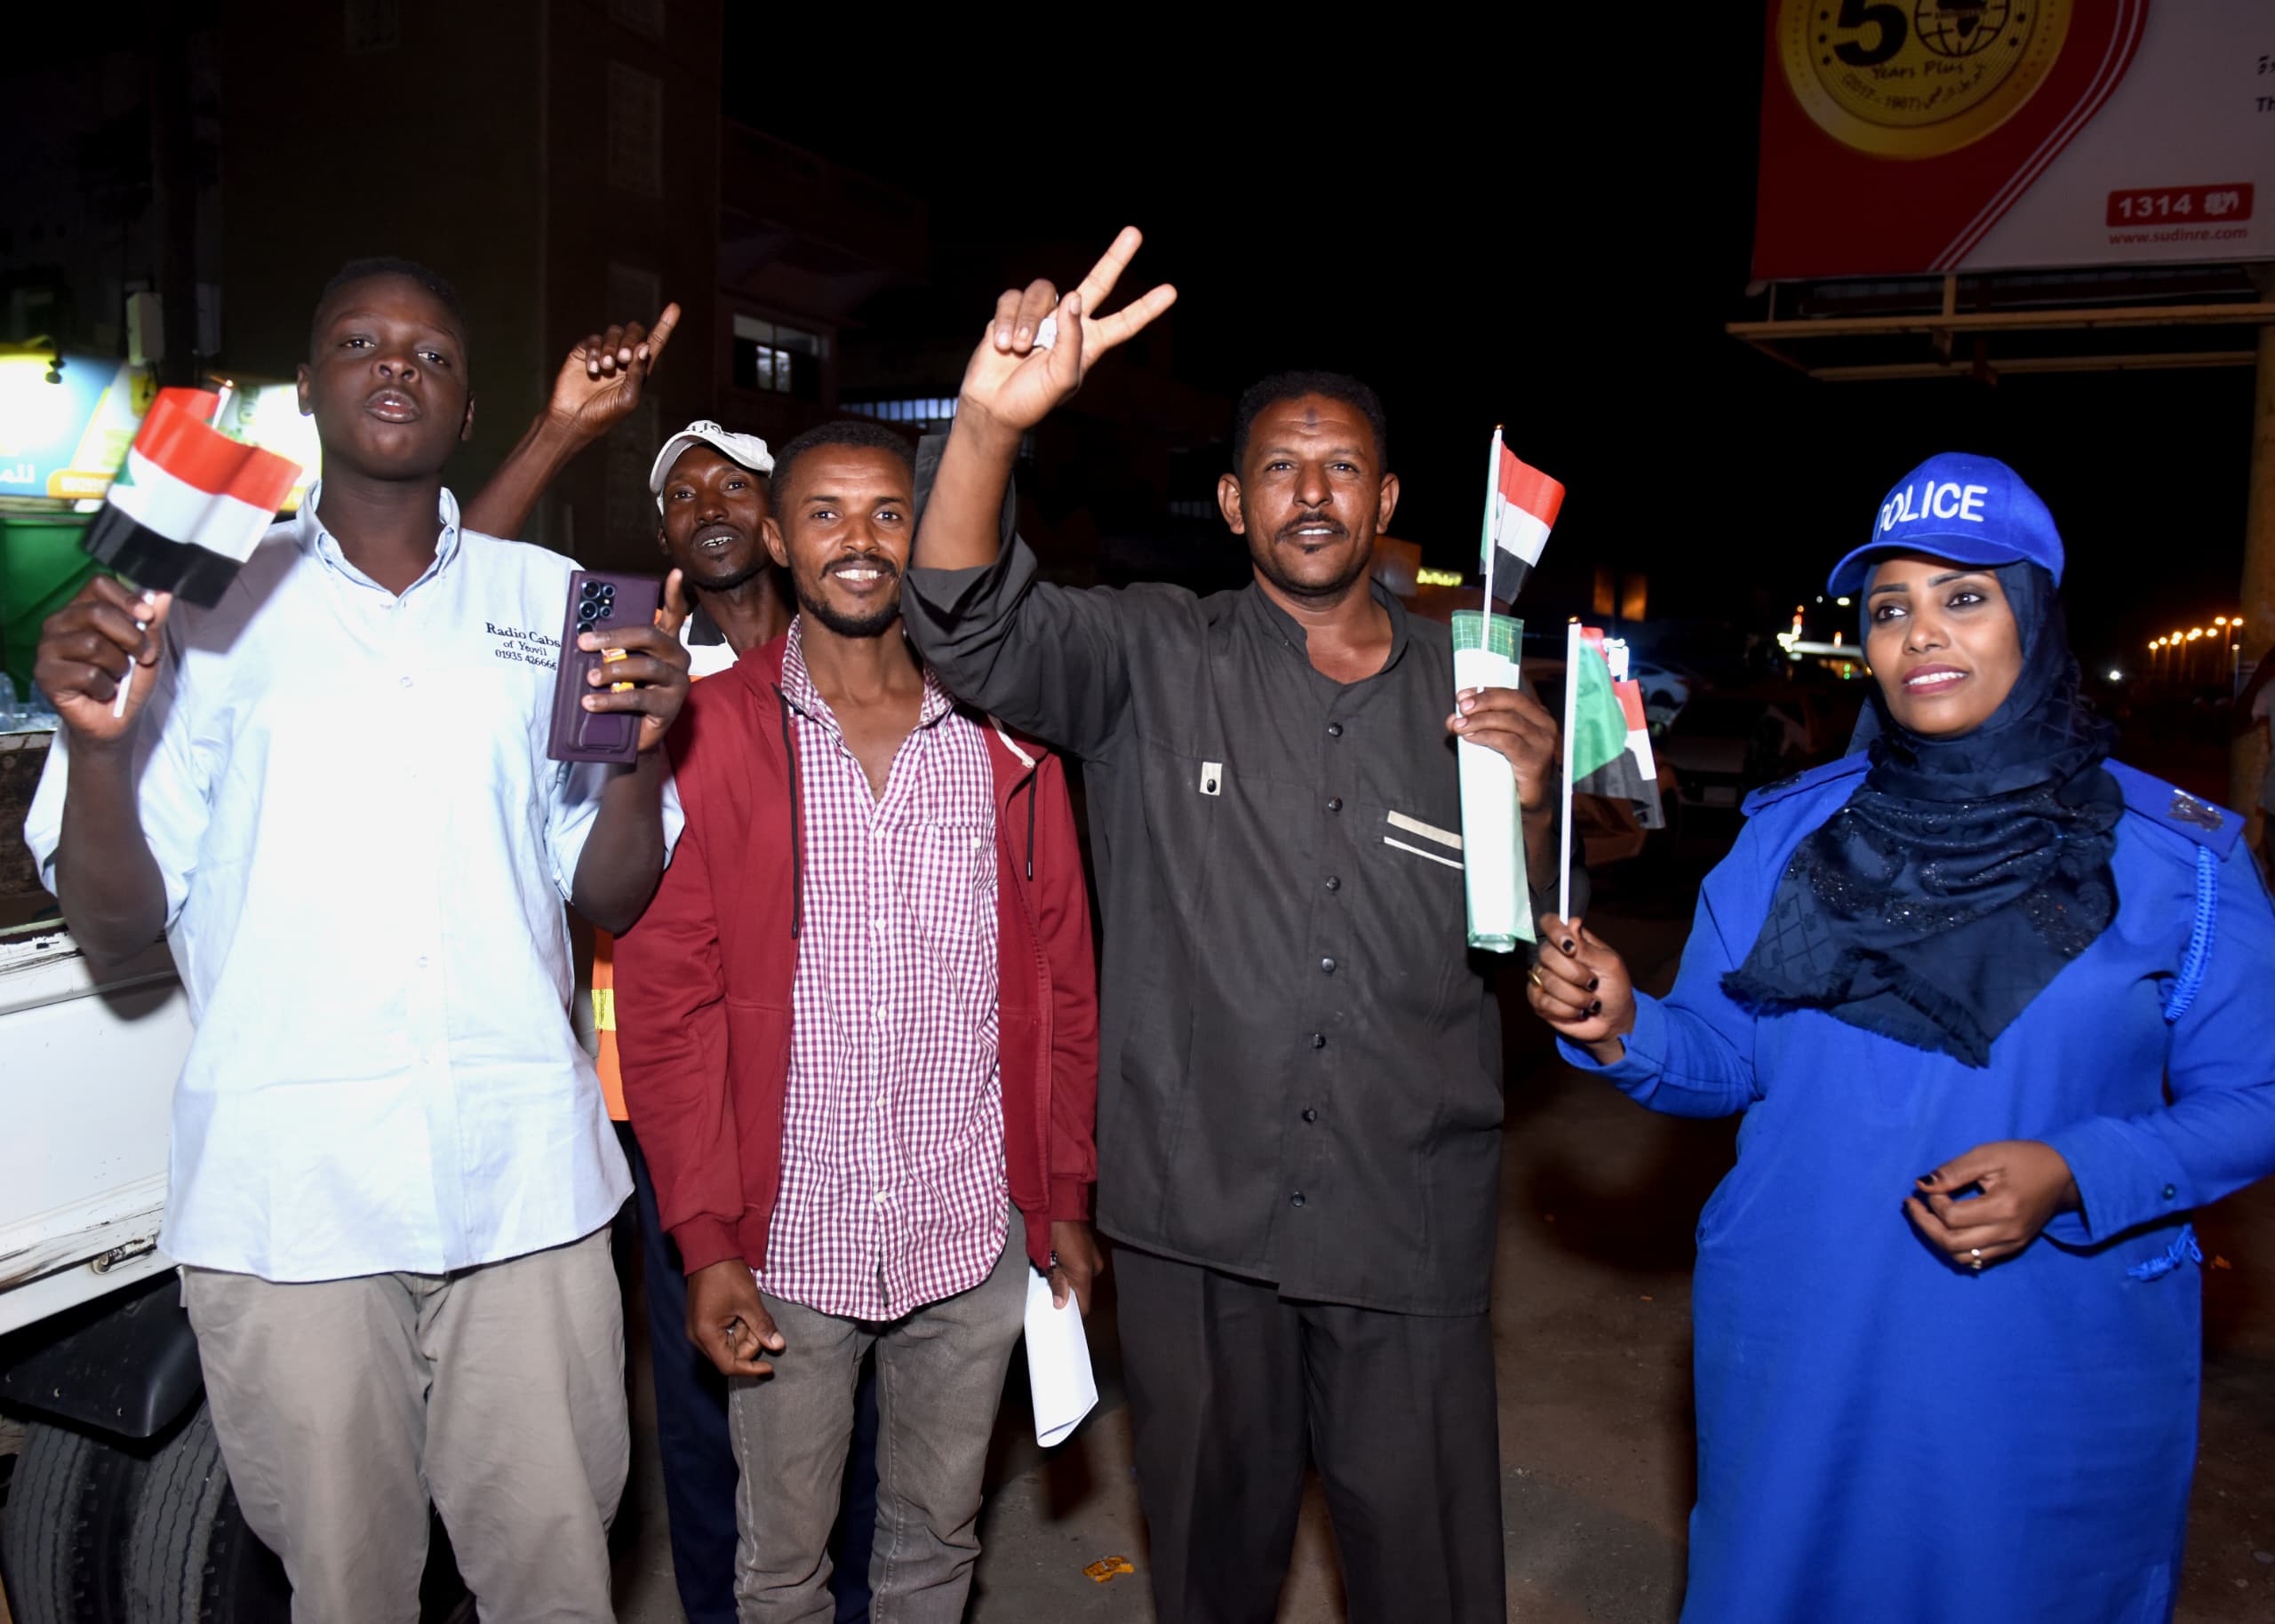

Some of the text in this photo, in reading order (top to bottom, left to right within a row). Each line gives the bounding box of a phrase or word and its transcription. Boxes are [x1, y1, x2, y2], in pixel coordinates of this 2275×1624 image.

[1872, 60, 1963, 79] Years Plus
[2119, 193, 2193, 219] 1314
[2109, 227, 2248, 244] www.sudinre.com
[1876, 481, 1988, 541] POLICE
[485, 621, 562, 648] Radio Cabs
[495, 649, 523, 662] 01935
[503, 640, 547, 657] of Yeovil
